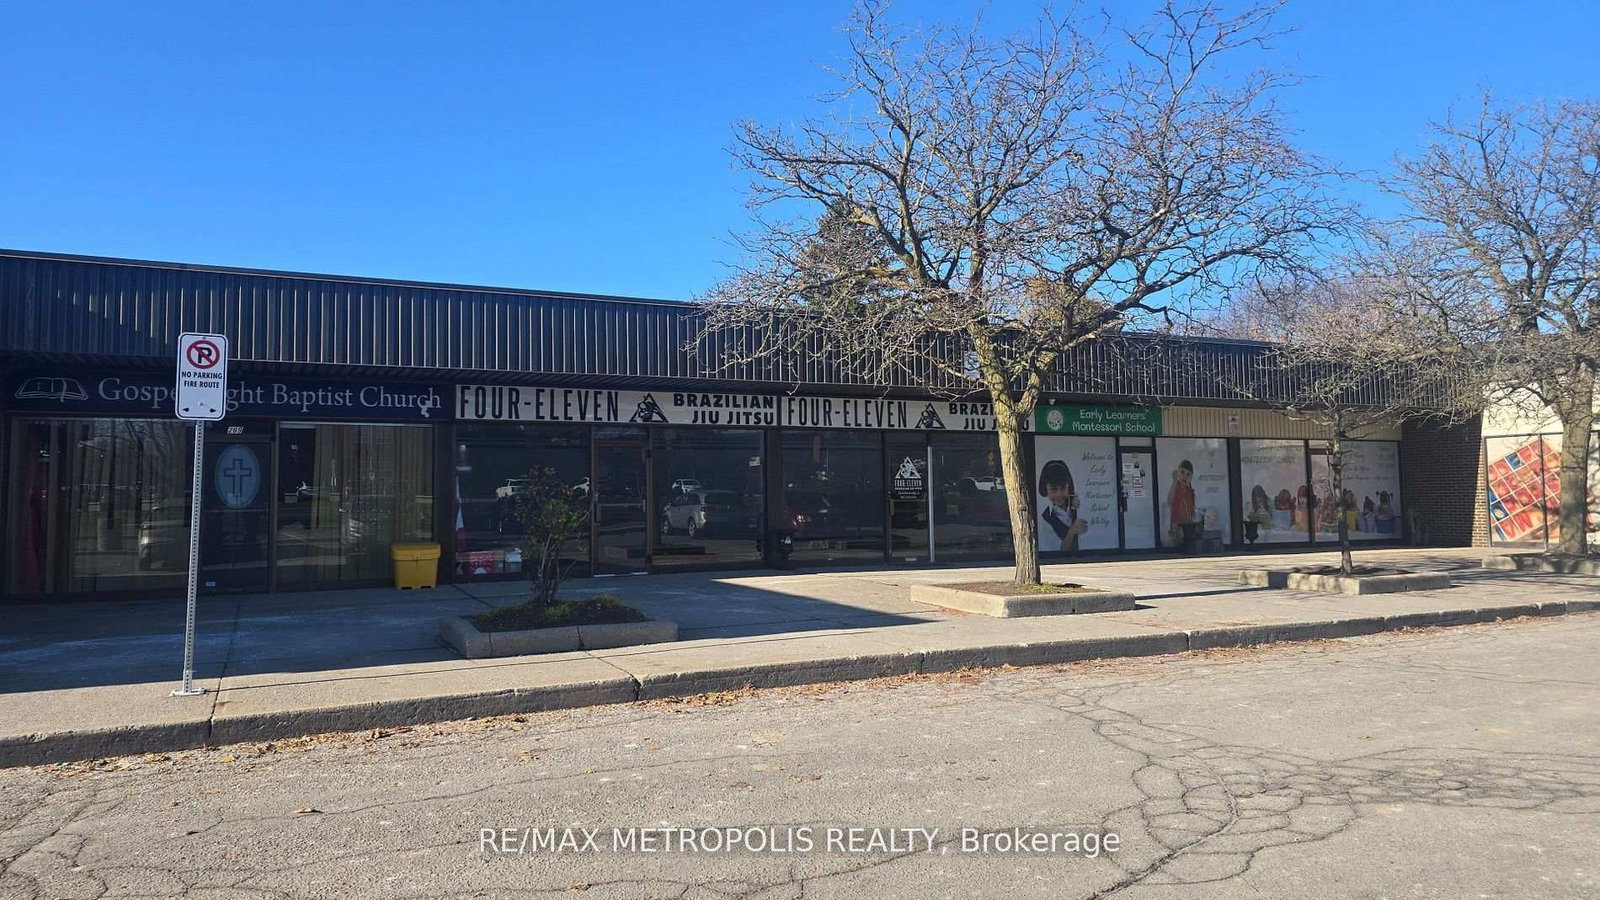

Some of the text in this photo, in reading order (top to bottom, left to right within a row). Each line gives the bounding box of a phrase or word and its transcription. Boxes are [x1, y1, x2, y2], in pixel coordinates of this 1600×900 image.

[193, 371, 222, 379] PARKING
[98, 377, 442, 413] Gospe ght Baptist Church
[673, 393, 774, 409] BRAZILIAN
[460, 385, 619, 422] FOUR-ELEVEN
[949, 403, 994, 416] BRAZI
[692, 410, 774, 425] JIU JITSU
[787, 397, 907, 428] FOUR-ELEVEN
[1080, 409, 1103, 422] Early
[964, 417, 986, 430] JIU
[1072, 421, 1155, 433] Montessori School
